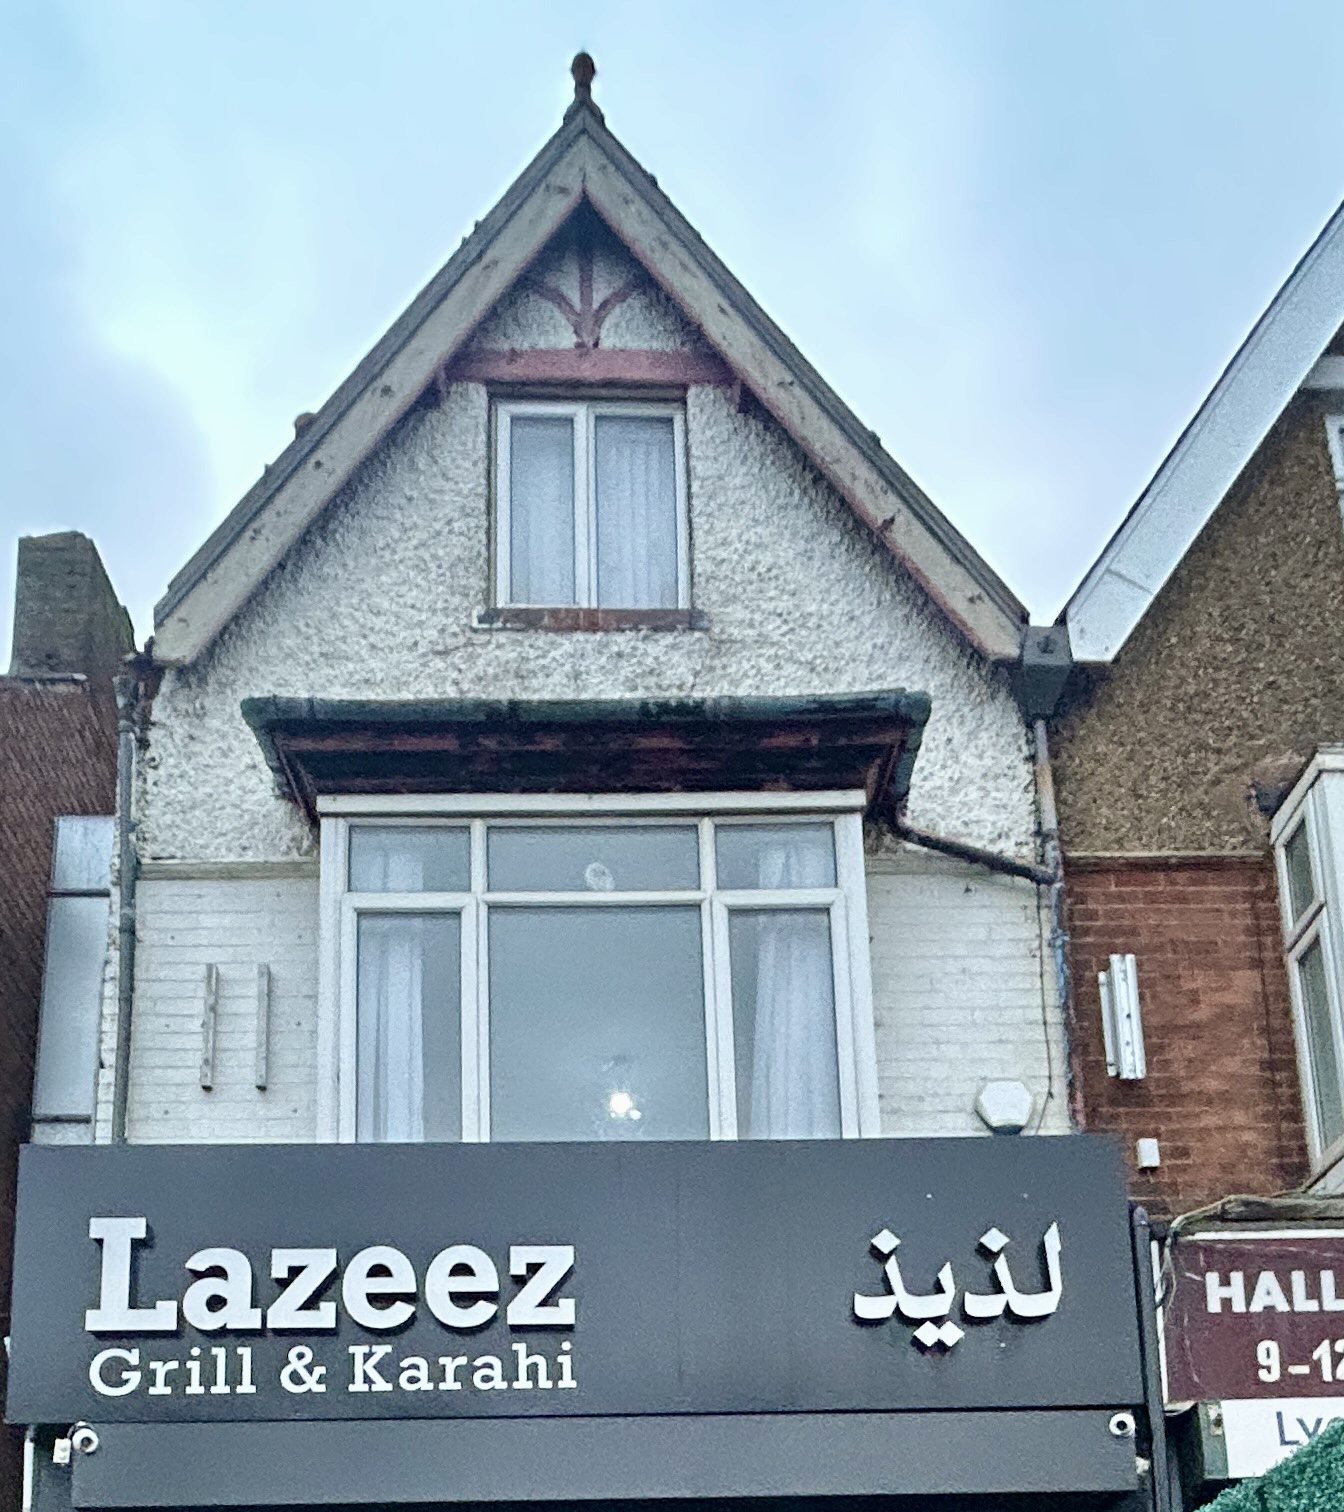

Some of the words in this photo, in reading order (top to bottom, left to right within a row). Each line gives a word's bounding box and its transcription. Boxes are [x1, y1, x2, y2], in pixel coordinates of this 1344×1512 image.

[85, 1217, 575, 1331] Lazeez
[854, 1221, 1062, 1347] لذيذ
[89, 1346, 256, 1397] Grill
[280, 1345, 326, 1393] &
[348, 1341, 576, 1392] Karahi
